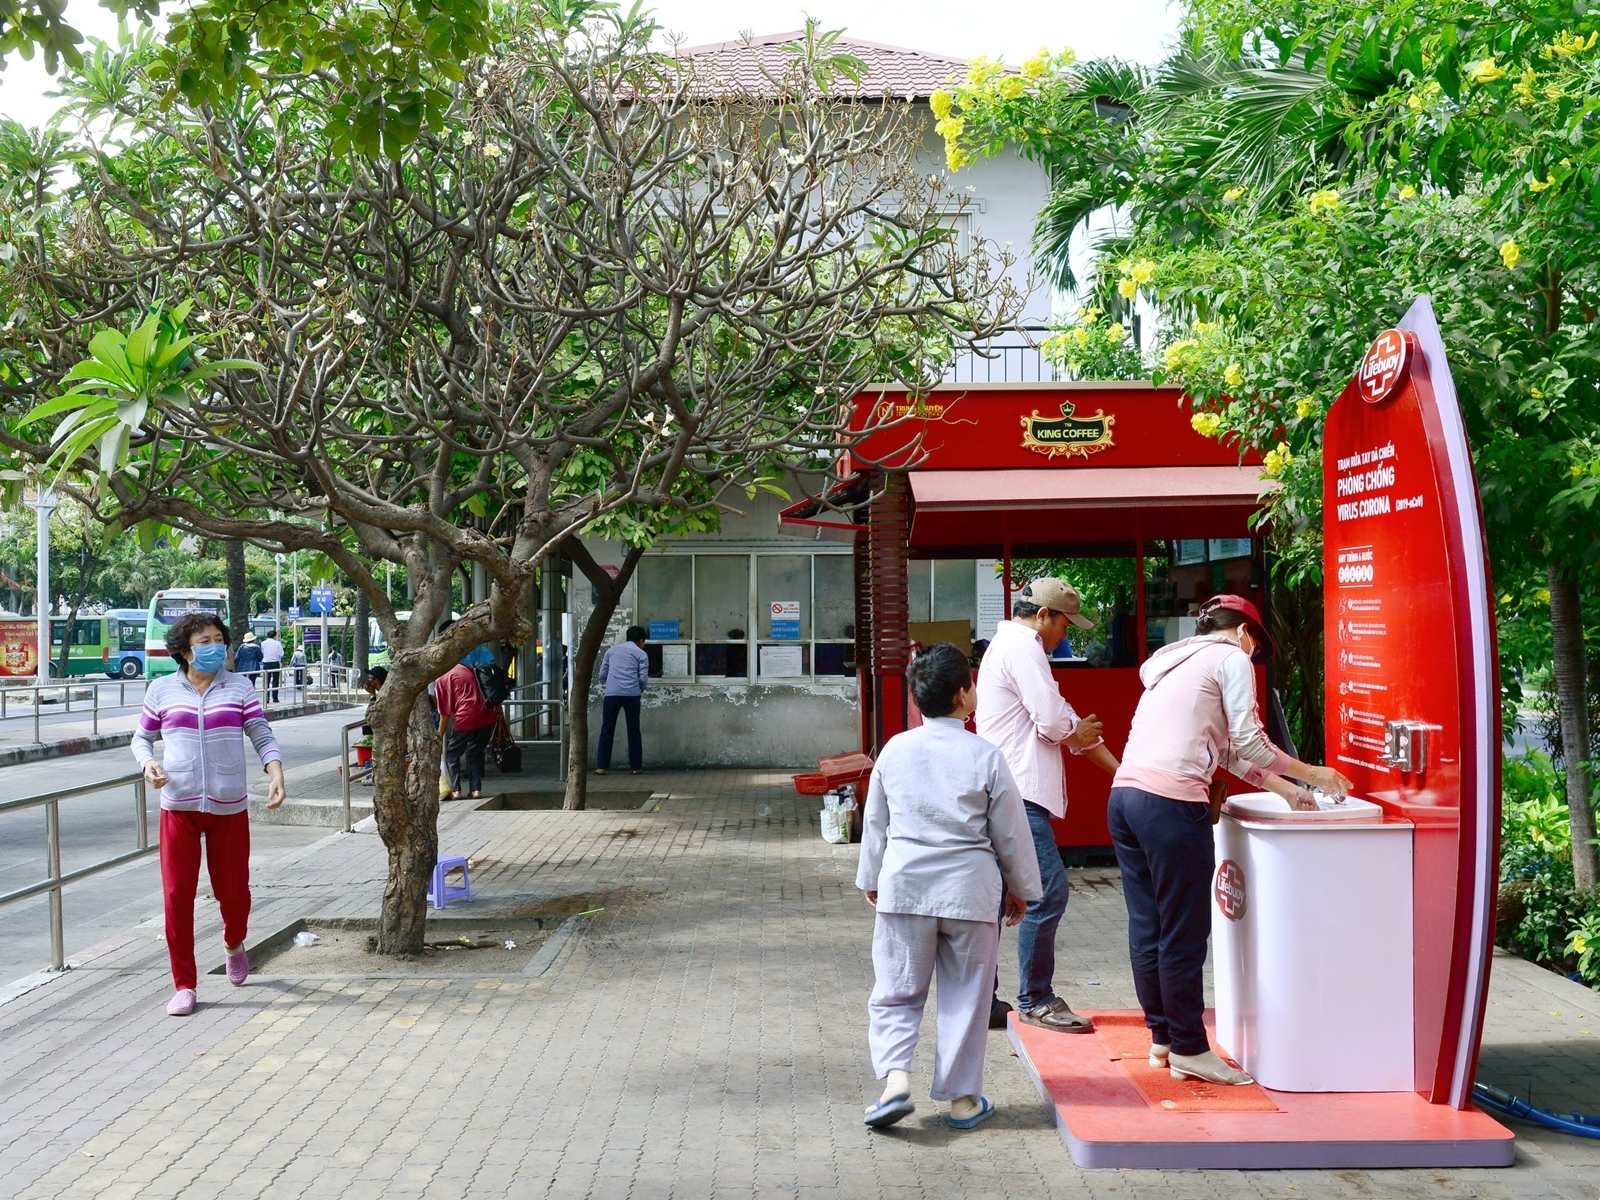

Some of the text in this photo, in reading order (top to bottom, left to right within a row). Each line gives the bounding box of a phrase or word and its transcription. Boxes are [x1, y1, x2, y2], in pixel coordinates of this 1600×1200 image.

[1363, 353, 1400, 380] Lifebuoy
[1037, 429, 1099, 438] KING COFFEE
[1337, 457, 1350, 472] TRẠM
[1351, 452, 1361, 467] RỬA
[1361, 450, 1371, 465] TAY
[1379, 440, 1395, 460] CHIẾN
[1337, 461, 1395, 497] PHÒNG CHỐNG
[1337, 502, 1358, 521] VIRUS
[1359, 495, 1391, 517] CORONA
[1217, 875, 1245, 905] Lifebuoy
